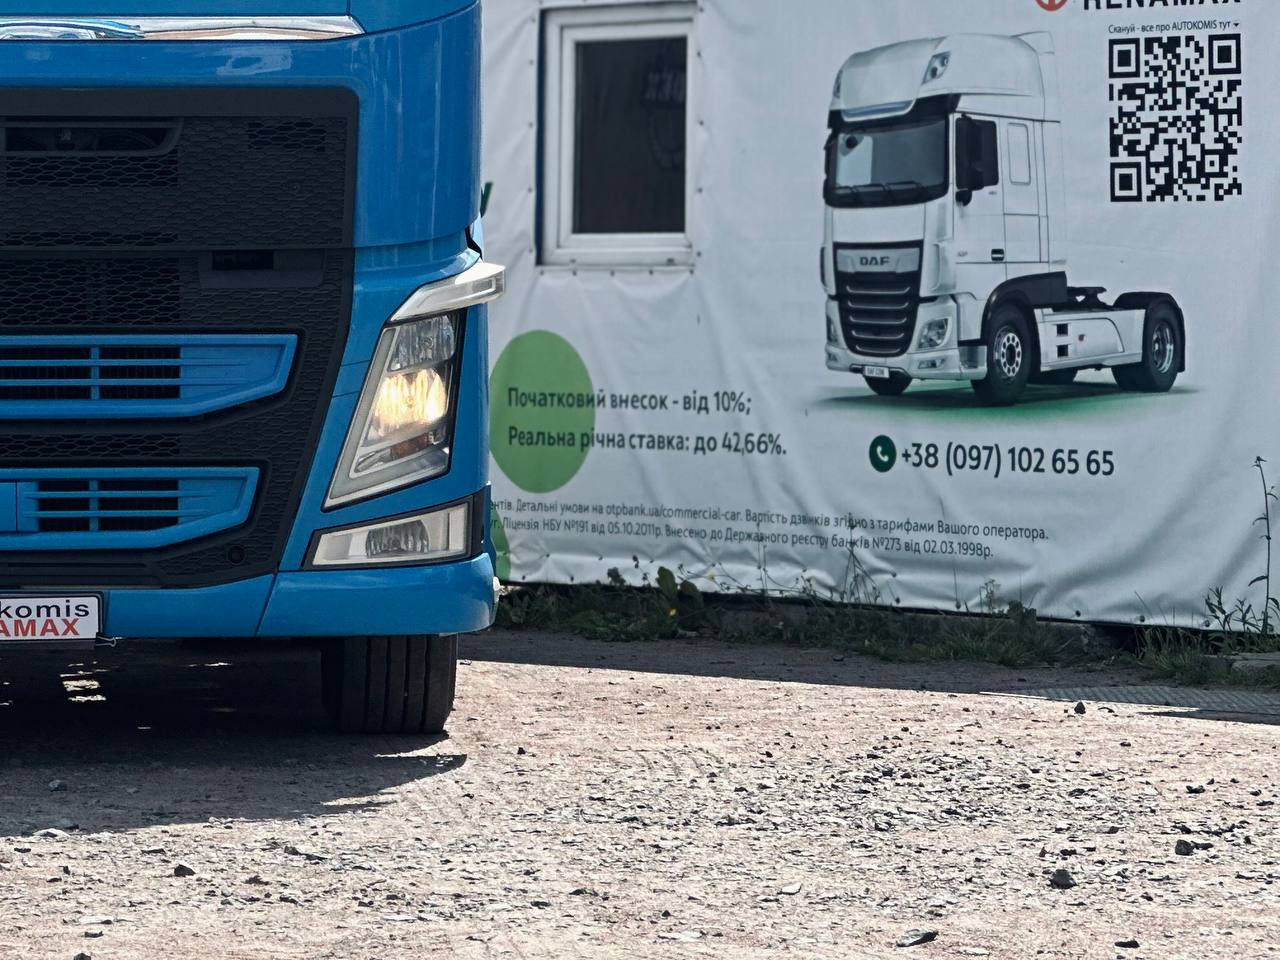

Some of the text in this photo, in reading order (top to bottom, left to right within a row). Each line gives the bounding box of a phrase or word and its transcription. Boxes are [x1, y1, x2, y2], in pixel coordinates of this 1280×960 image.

[1109, 24, 1135, 34] Скануй
[1141, 24, 1154, 32] все
[1155, 23, 1170, 34] про
[1172, 20, 1218, 31] AUTOKOMIS
[1219, 21, 1231, 30] тут
[859, 256, 890, 266] DAF
[507, 387, 606, 409] Початковий
[610, 392, 668, 410] внесок
[683, 391, 709, 414] від
[713, 391, 752, 416] 10%;
[508, 426, 576, 447] Реальна
[580, 427, 625, 452] річна
[628, 434, 690, 451] ставка:
[693, 434, 717, 454] до
[902, 441, 1115, 478] +38 (097) 102 65 65
[516, 498, 558, 512] Детальні
[560, 503, 589, 516] умови
[592, 504, 604, 514] на
[877, 518, 935, 534] тарифами
[937, 520, 980, 536] Вашого
[982, 525, 1049, 542] оператора.
[503, 517, 540, 531] Ліцензія
[543, 518, 562, 531] НБУ
[564, 519, 589, 533] №191
[591, 521, 605, 535] від
[665, 525, 707, 539] Внесено
[710, 529, 723, 541] до
[872, 537, 901, 551] №273
[904, 539, 921, 554] від
